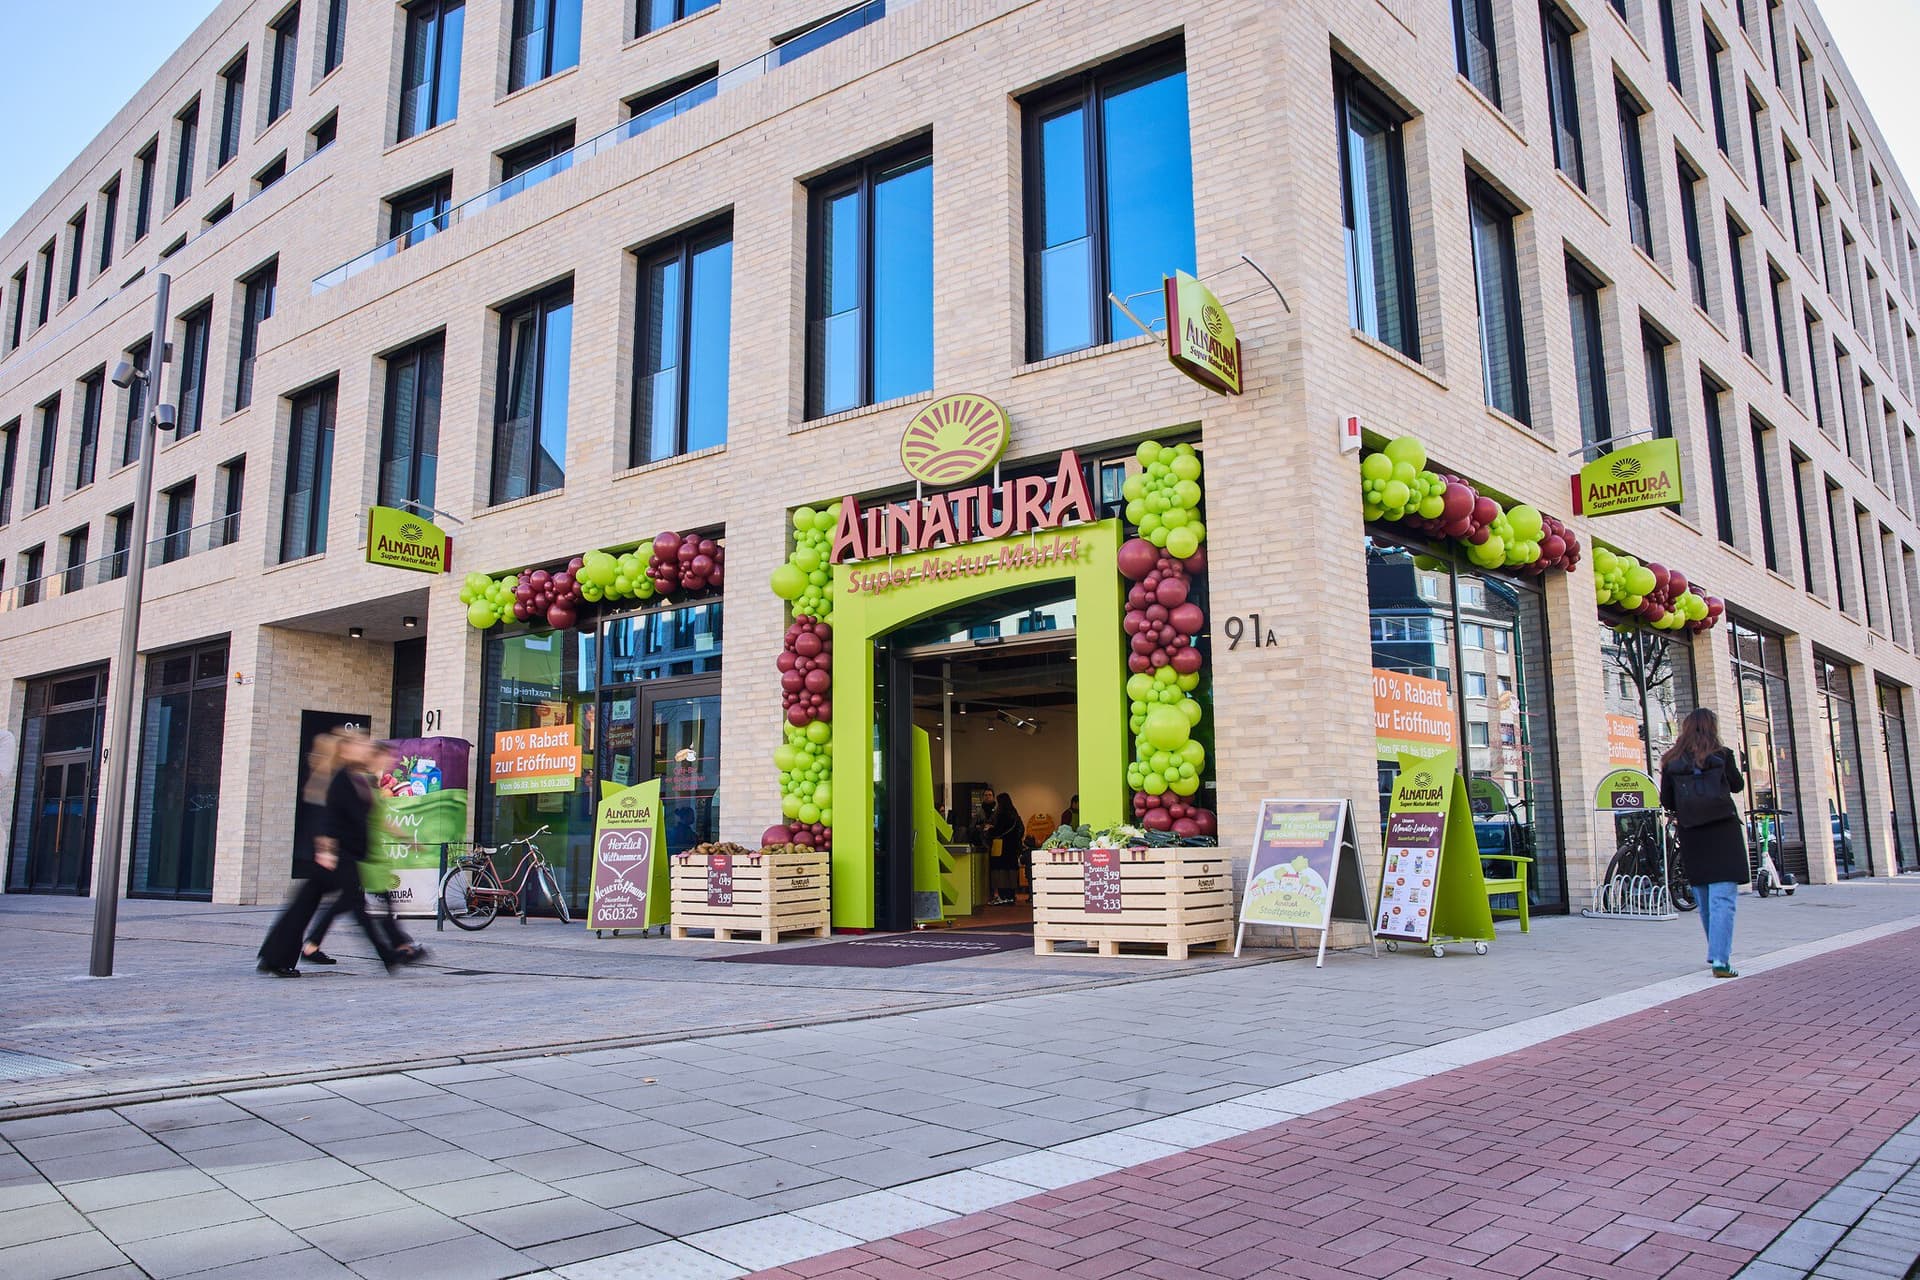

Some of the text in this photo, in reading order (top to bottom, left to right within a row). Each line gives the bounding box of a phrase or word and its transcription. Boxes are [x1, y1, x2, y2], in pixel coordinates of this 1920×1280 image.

[1186, 317, 1237, 373] ALNATURA
[1190, 345, 1235, 381] Super Natur Markt
[1588, 470, 1671, 502] ALNATURA
[829, 449, 1097, 564] ALNATURA
[1593, 491, 1667, 509] Super Natur Markt
[377, 534, 440, 561] ALNATURA
[381, 552, 437, 567] Super Natur Markt
[847, 535, 1081, 595] Super Natur Markt
[1373, 677, 1443, 707] 10 % Rabatt
[426, 709, 442, 731] 91
[1393, 709, 1451, 742] Eröffnung
[1612, 720, 1635, 738] Rabatt
[500, 732, 569, 751] 10 % Rabatt
[1377, 743, 1392, 754] Vom
[1608, 742, 1641, 764] Eröffnung
[495, 753, 576, 774] zur Eröffnung
[500, 782, 513, 790] Vom
[1399, 785, 1443, 800] ALNATURA
[605, 806, 650, 819] ALNATURA
[607, 837, 642, 850] Herzlich
[602, 852, 642, 862] Willkommen
[595, 880, 647, 903] Neueröffnung
[791, 878, 810, 886] ALNATURA
[597, 907, 638, 921] 06.03.25
